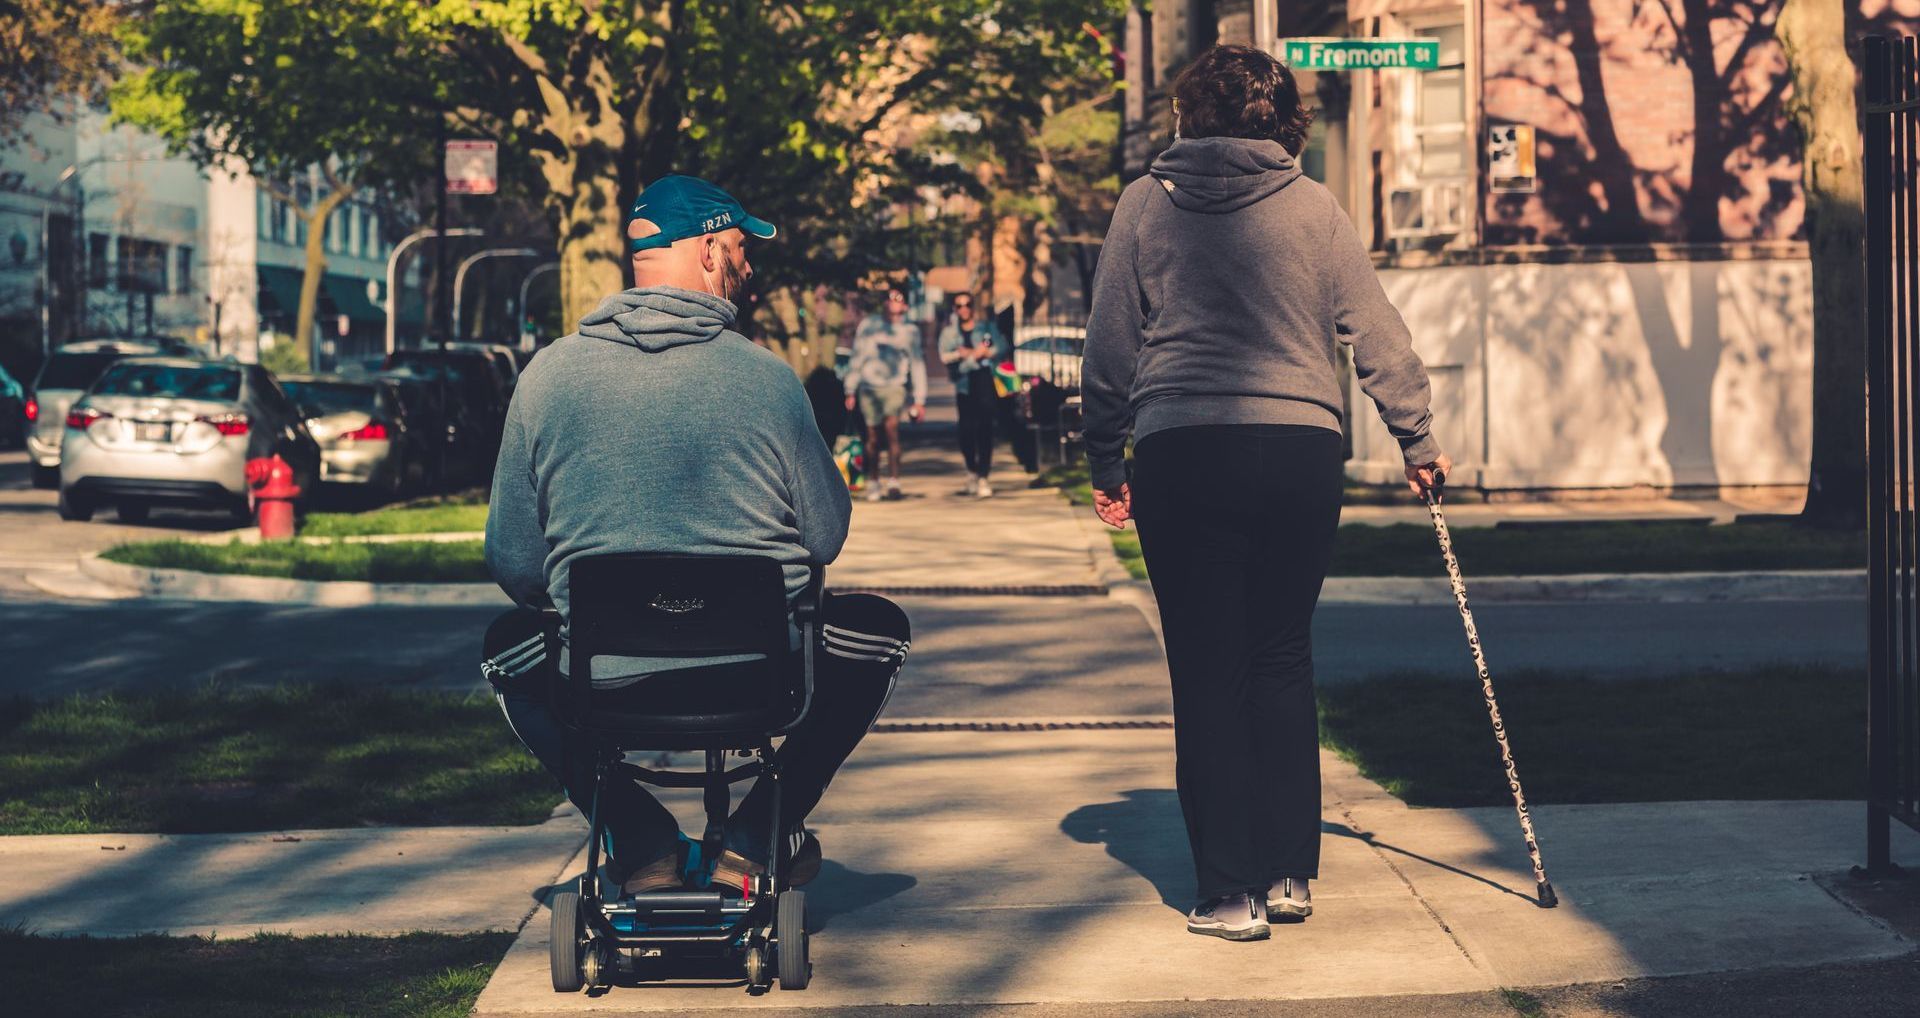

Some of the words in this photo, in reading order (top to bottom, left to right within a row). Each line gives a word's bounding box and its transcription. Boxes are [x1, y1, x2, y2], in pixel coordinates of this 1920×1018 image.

[1291, 47, 1304, 63] N
[1309, 43, 1408, 66] Fremont
[1414, 46, 1431, 63] St
